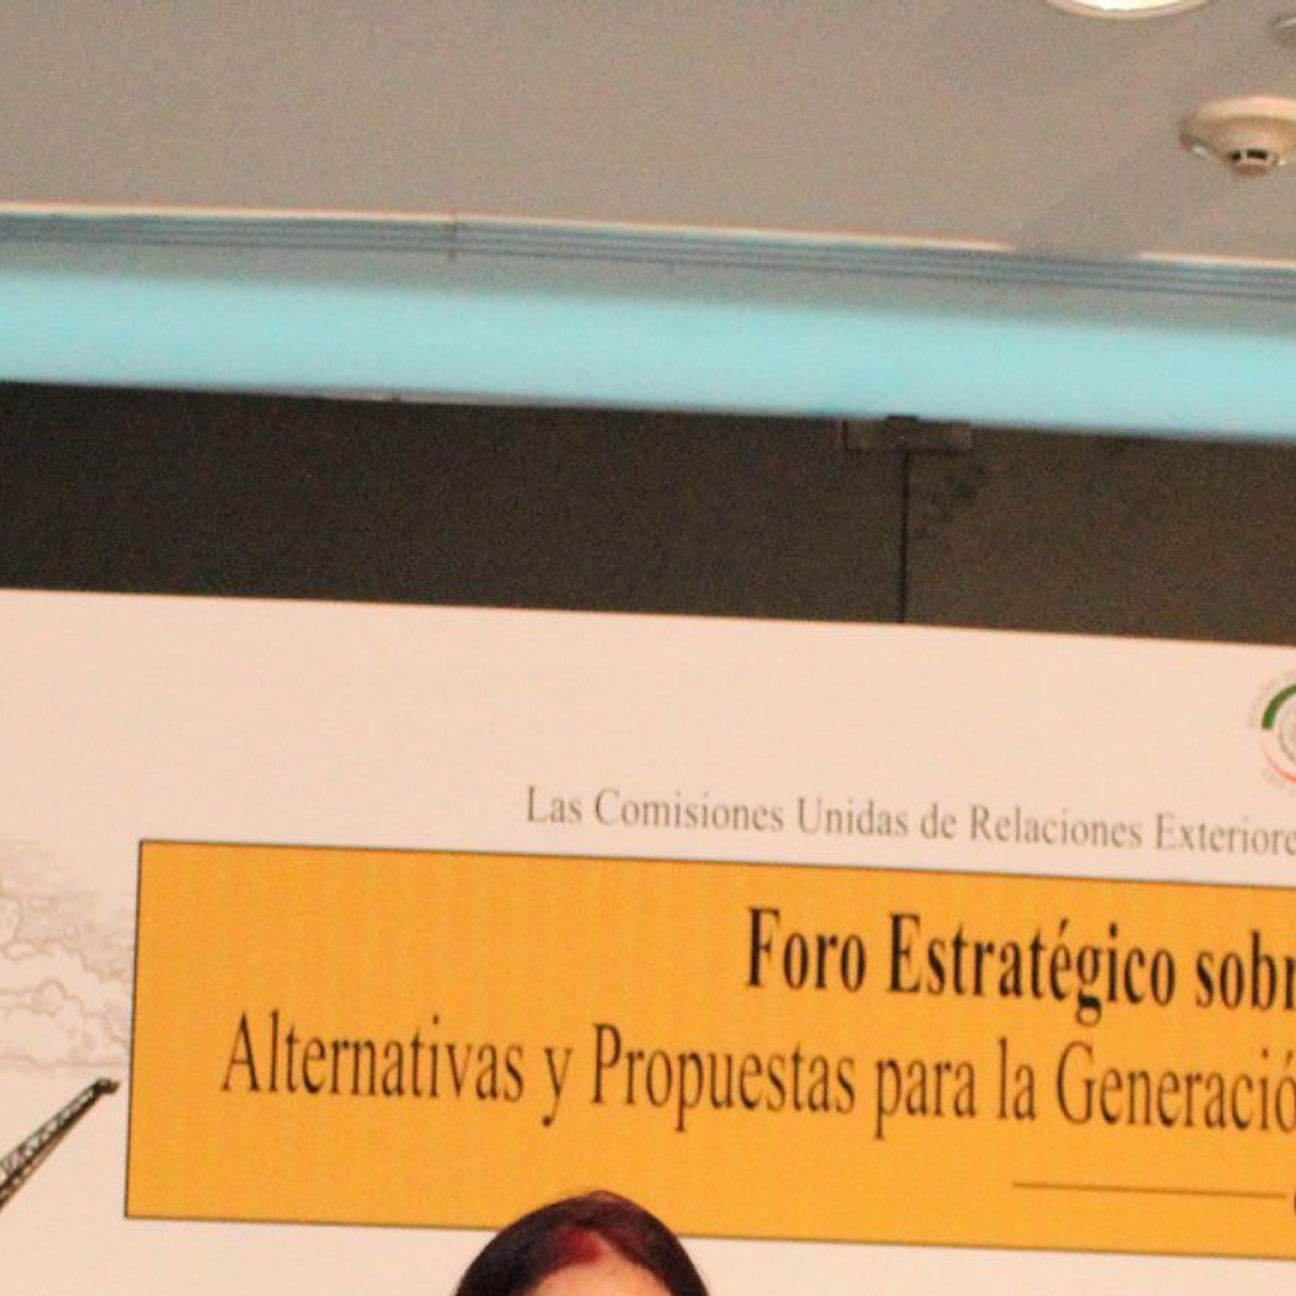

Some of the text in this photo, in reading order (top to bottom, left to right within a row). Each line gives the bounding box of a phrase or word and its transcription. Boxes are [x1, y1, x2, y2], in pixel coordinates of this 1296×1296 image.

[527, 785, 583, 824] Las
[593, 788, 785, 832] Comisiones
[797, 796, 909, 837] Unidas
[919, 802, 957, 840] de
[970, 804, 1143, 849] Relaciones
[747, 906, 867, 992] Foro
[888, 913, 1176, 1025] Estratégico
[221, 1008, 525, 1102] Alternativas
[541, 1046, 573, 1128] y
[591, 1022, 856, 1134] Propuestas
[874, 1058, 977, 1141] para
[997, 1036, 1037, 1122] la
